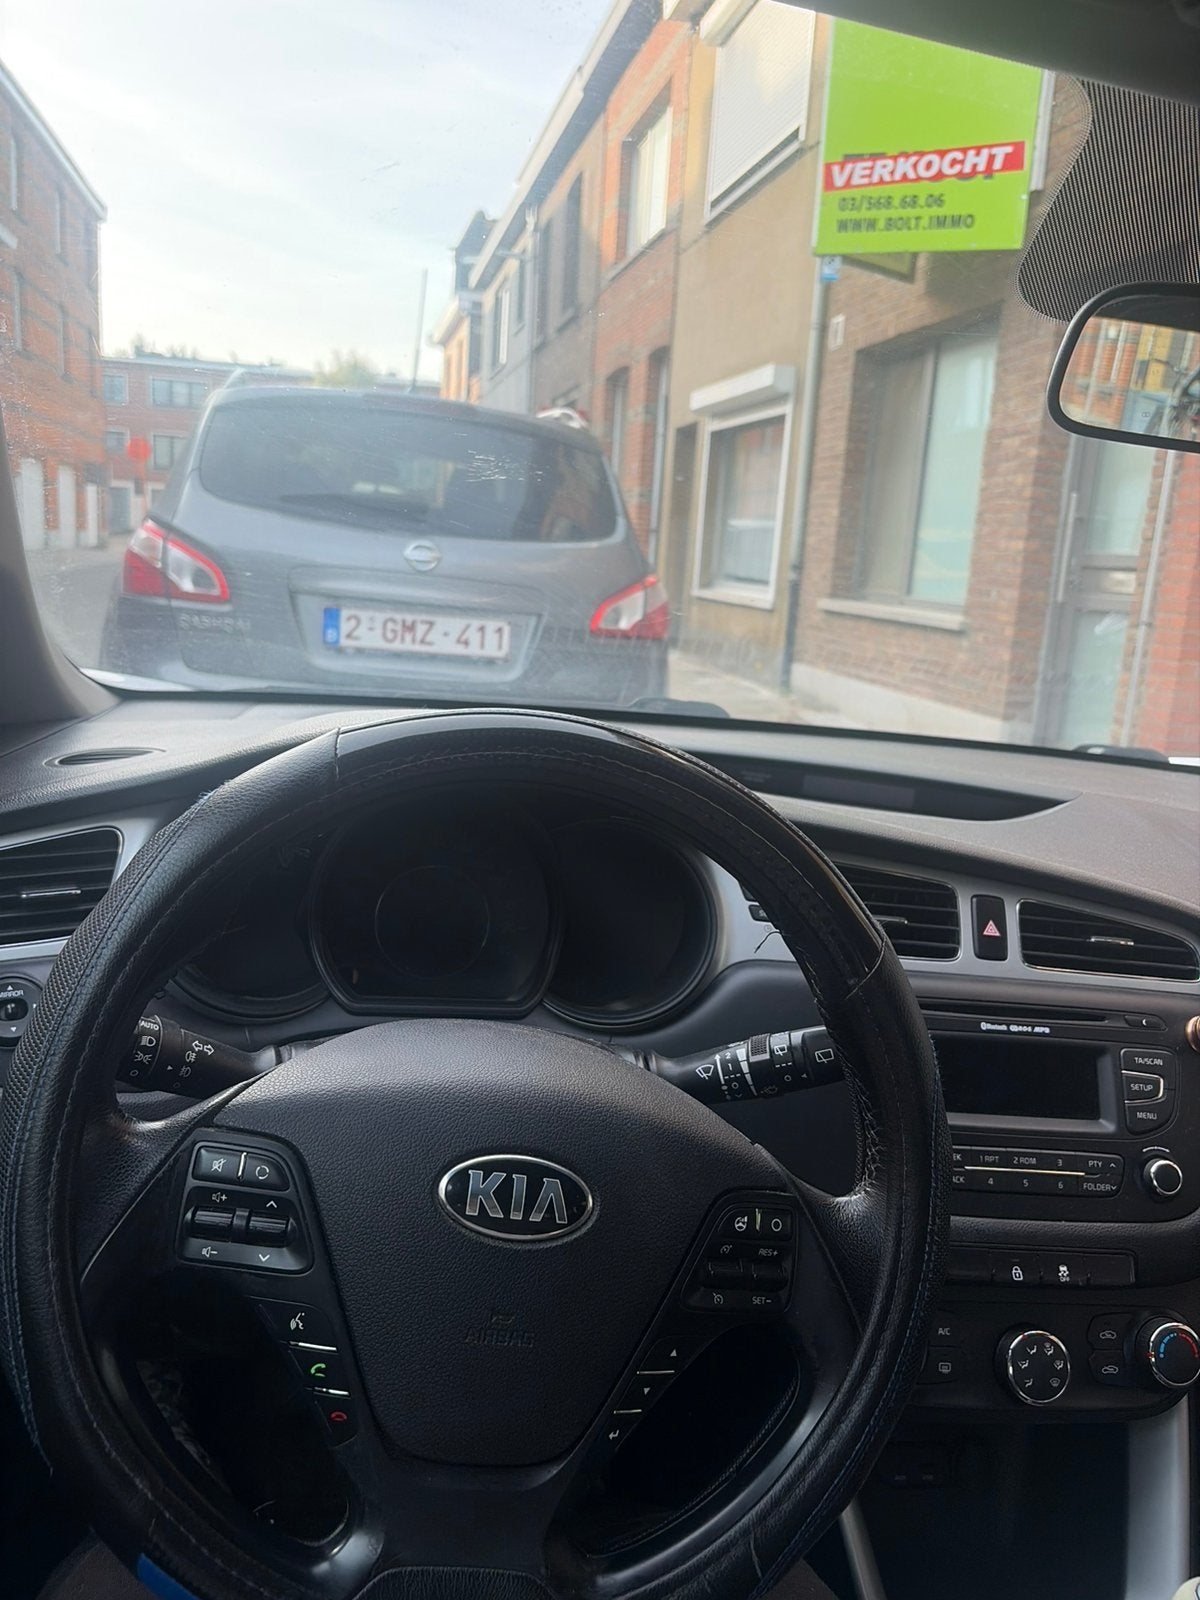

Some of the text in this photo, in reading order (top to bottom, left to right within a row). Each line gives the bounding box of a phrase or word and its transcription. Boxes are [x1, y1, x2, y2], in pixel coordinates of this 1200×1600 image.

[831, 146, 1013, 187] VERKOCHT
[837, 214, 975, 233] WWW.BOLT.IMMO
[140, 1020, 160, 1031] AUTO
[1134, 1056, 1163, 1067] TA/SCAN
[1130, 1083, 1154, 1092] SETUP
[1136, 1111, 1158, 1121] MENU
[953, 1154, 962, 1162] EK
[1057, 1159, 1063, 1167] 3
[1088, 1160, 1103, 1169] PTY
[987, 1177, 995, 1185] 4
[1023, 1180, 1030, 1188] 5
[1058, 1181, 1064, 1190] 6
[1083, 1183, 1111, 1193] FOLDER
[466, 1170, 568, 1224] KIA
